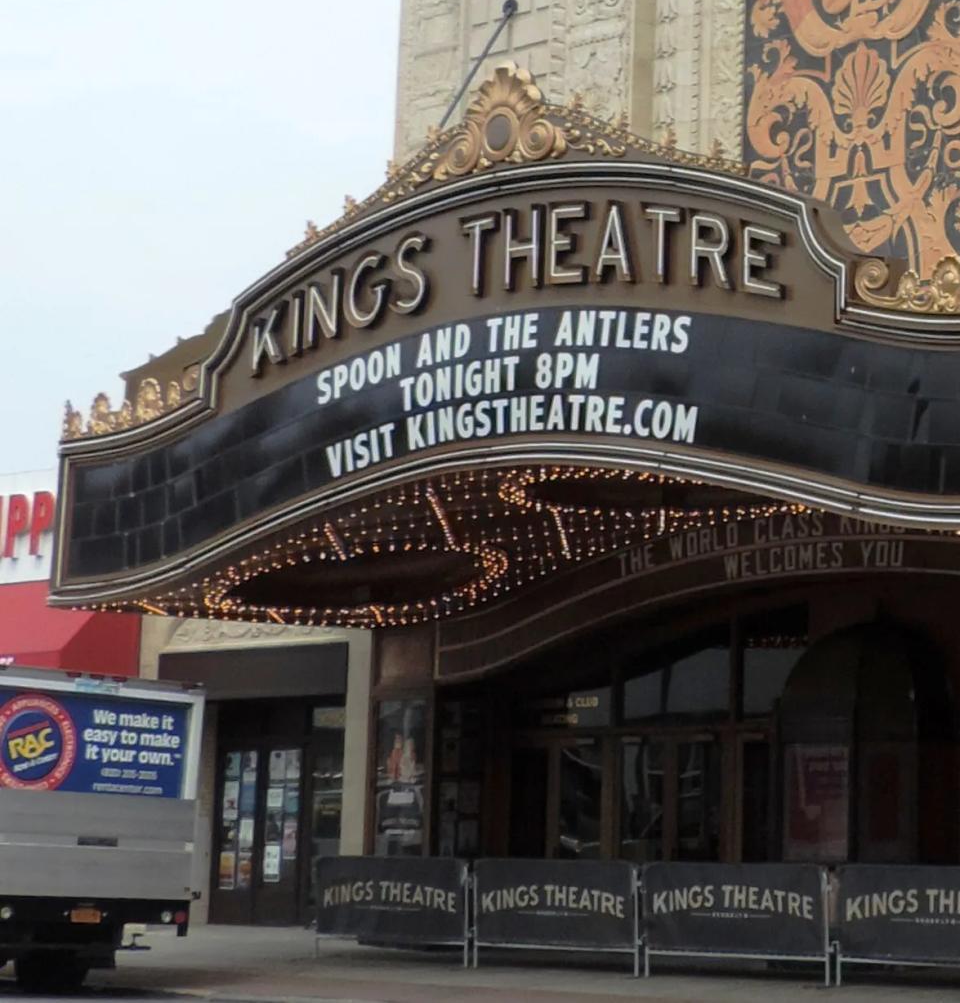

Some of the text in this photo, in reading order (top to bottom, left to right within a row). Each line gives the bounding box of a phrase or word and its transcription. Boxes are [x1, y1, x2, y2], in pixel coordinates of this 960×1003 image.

[250, 201, 787, 377] KINGS THEATRE
[316, 310, 691, 404] SPOON AND THE ANTLERS
[400, 353, 599, 412] TONIGHT 8PM
[325, 394, 698, 477] VISIT KINGSTHEATRE.COM
[0, 491, 55, 558] PP
[617, 545, 656, 577] THE
[669, 522, 738, 560] WORLD
[754, 512, 824, 542] CLASS
[724, 541, 904, 580] WELCOMES YOU
[84, 728, 180, 748] easy to make
[93, 709, 174, 731] We make it
[8, 728, 55, 760] RAC
[85, 744, 99, 760] it
[102, 748, 136, 763] your
[323, 881, 457, 914] KINGS THEATRE
[481, 885, 625, 918] KINGS THEATRE
[652, 885, 814, 921] KINGS THEATRE
[845, 889, 919, 922] KINGS
